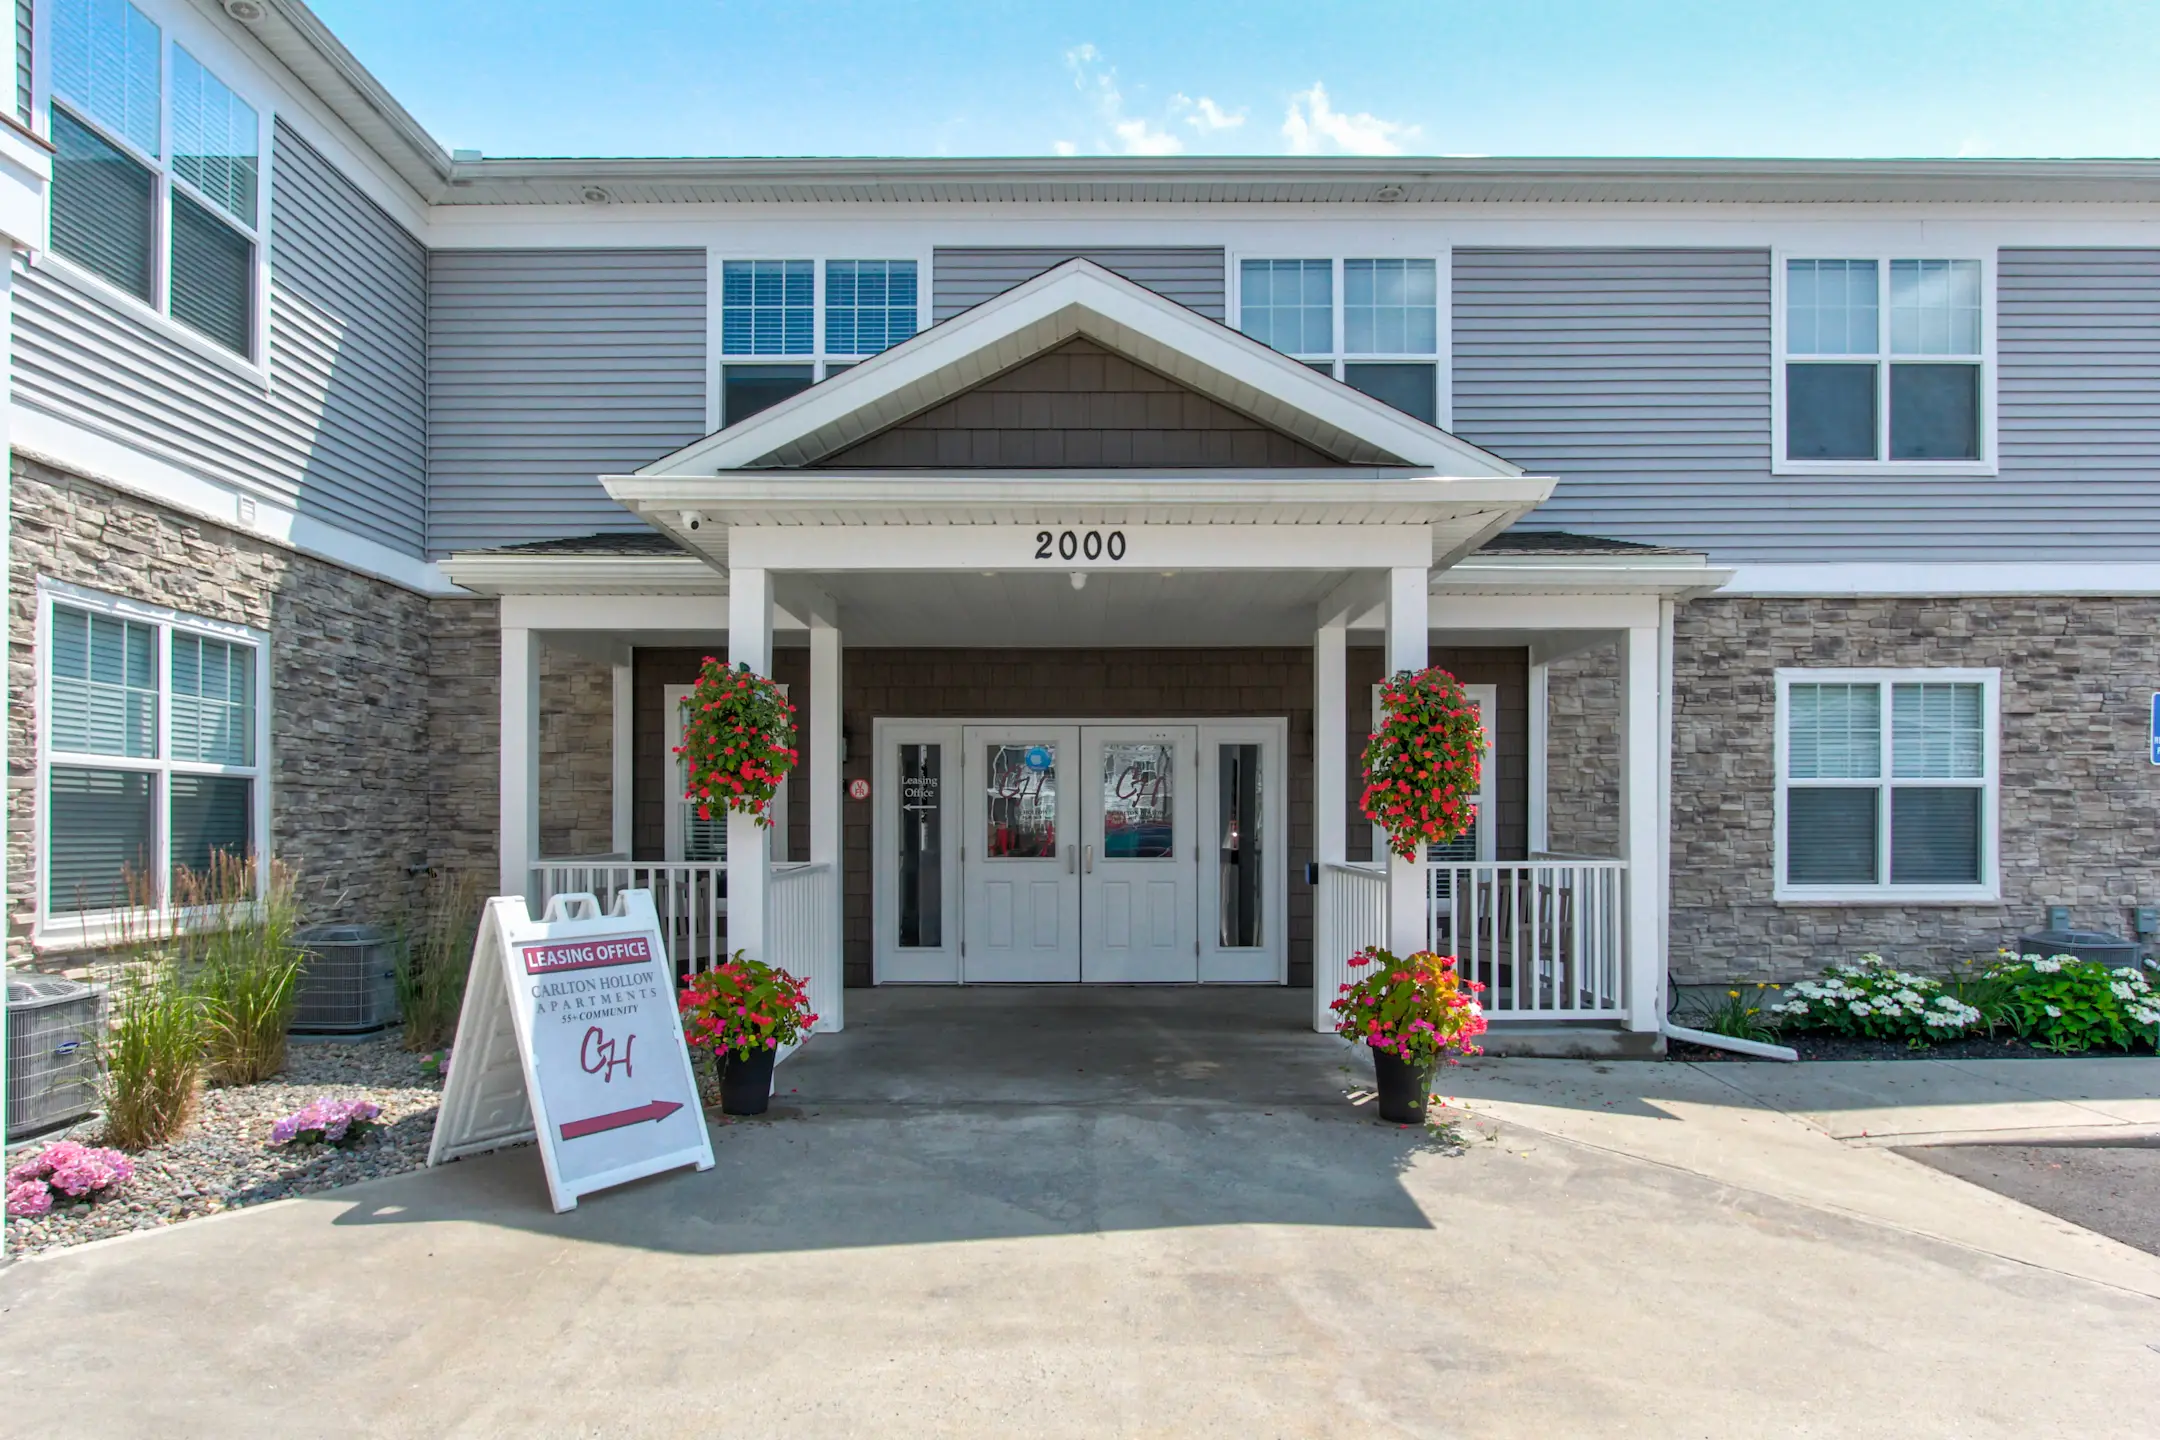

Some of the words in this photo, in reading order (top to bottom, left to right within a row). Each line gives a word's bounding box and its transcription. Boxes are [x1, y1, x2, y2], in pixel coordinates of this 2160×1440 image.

[1035, 530, 1126, 560] 2000
[855, 788, 864, 796] FR
[901, 776, 938, 787] Leasing
[904, 788, 934, 797] Office
[527, 947, 594, 968] LEASING
[596, 941, 647, 960] OFFICE
[531, 978, 597, 998] CARLTON
[600, 971, 654, 990] HOLLOW
[537, 987, 657, 1014] APARTMENTS
[581, 1026, 636, 1083] CH
